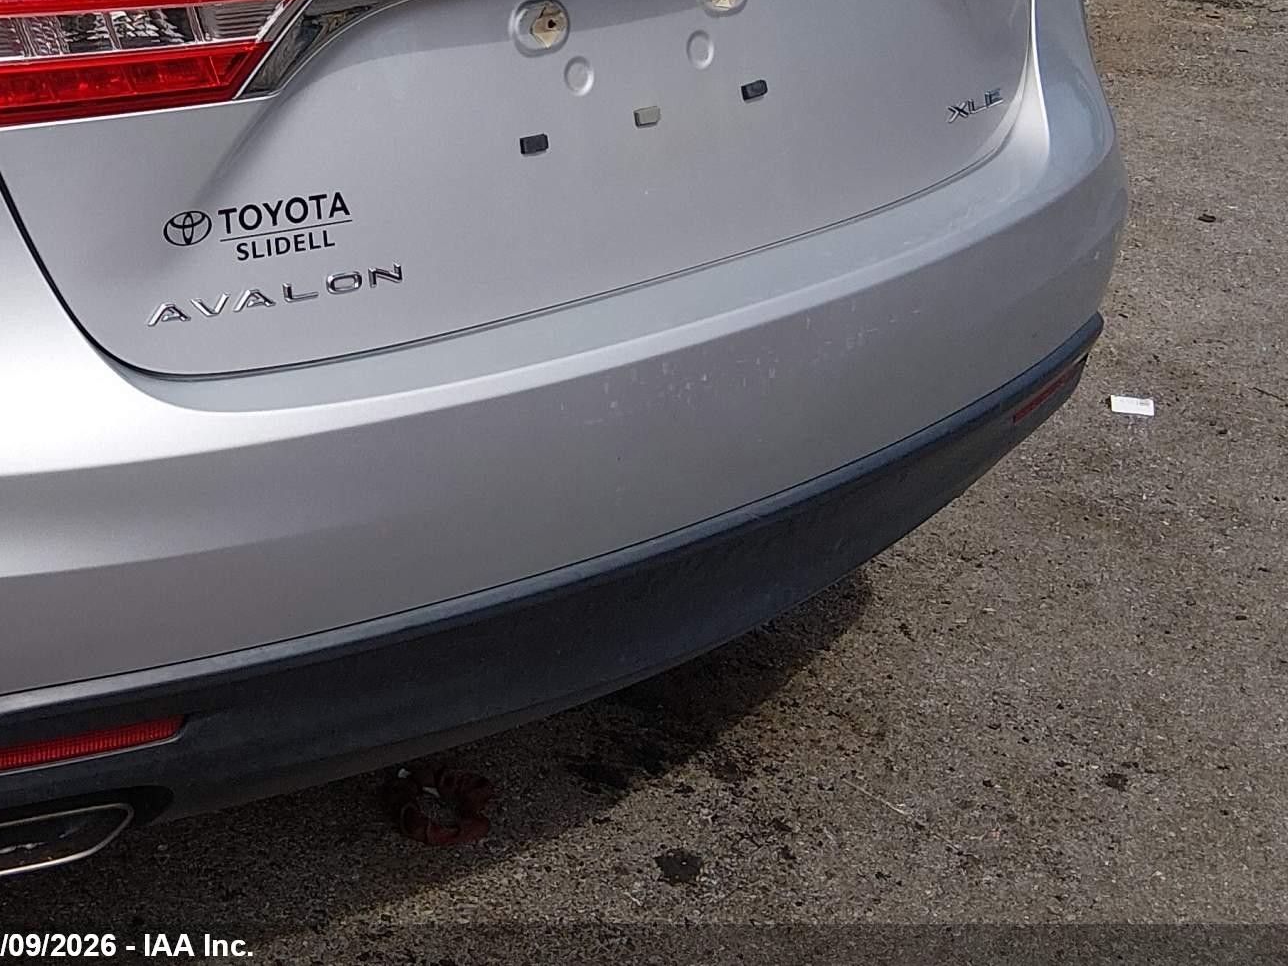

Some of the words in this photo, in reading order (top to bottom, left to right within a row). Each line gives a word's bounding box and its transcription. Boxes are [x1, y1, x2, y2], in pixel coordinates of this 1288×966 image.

[946, 88, 1004, 124] XLE
[218, 191, 351, 234] TOYOTA
[236, 230, 336, 261] SLIDELL
[147, 263, 404, 327] AVALON
